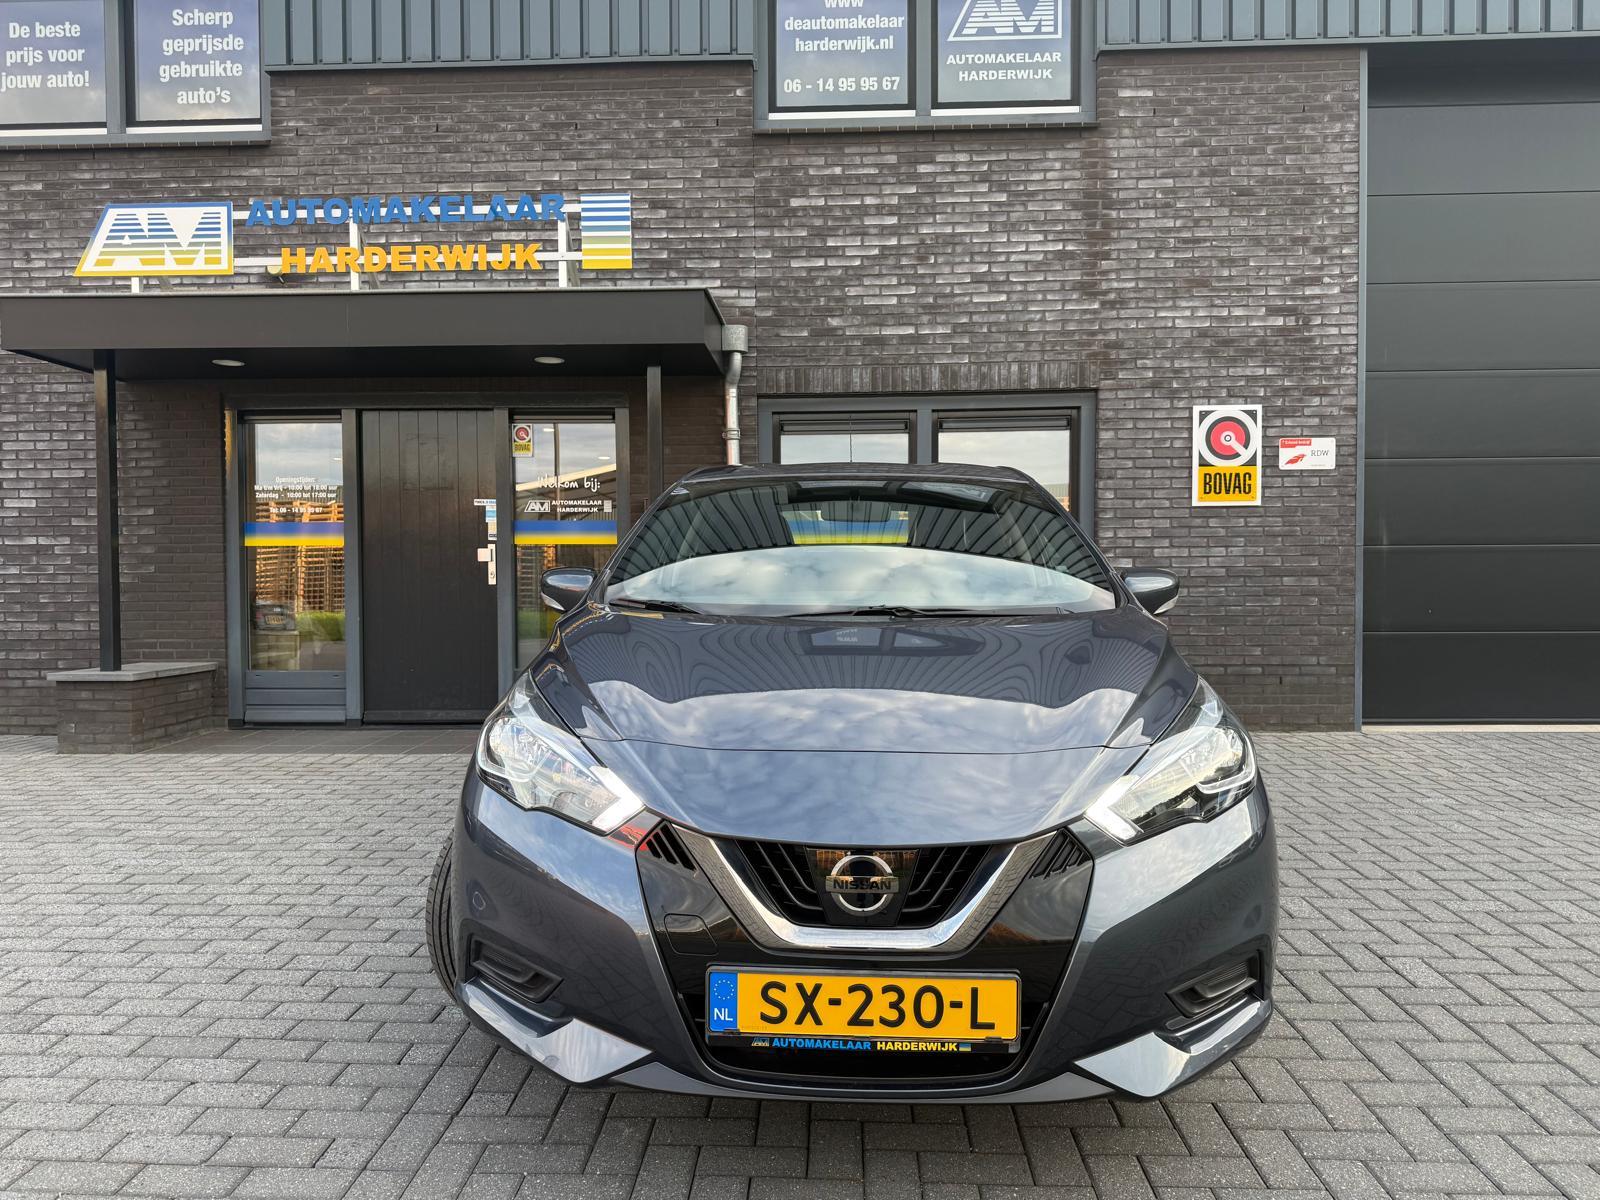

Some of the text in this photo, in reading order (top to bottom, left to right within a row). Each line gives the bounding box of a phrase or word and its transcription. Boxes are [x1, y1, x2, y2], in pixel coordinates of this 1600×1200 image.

[172, 8, 233, 28] Scherp
[784, 14, 905, 31] deautomakelaar
[9, 21, 81, 39] De beste
[162, 34, 244, 55] geprijsde
[795, 34, 894, 53] harderwijk.nl
[6, 47, 86, 67] prijs voor
[946, 51, 1062, 65] AUTOMAKELAAR
[159, 61, 243, 82] gebruikte
[958, 68, 1053, 82] HARDERWIJK
[0, 70, 90, 92] jouw auto!
[783, 78, 802, 93] 06
[816, 78, 835, 93] 14
[838, 77, 857, 92] 95
[859, 76, 878, 92] 95
[882, 76, 900, 91] 67
[176, 87, 232, 104] auto's
[245, 193, 567, 228] AUTOMAKELAAR
[94, 211, 223, 268] AM
[281, 243, 544, 273] HARDERWIJK
[1311, 449, 1329, 457] RDW
[584, 476, 601, 492] bij:
[1203, 472, 1252, 495] BOVAG
[833, 880, 892, 890] NISSAN
[759, 980, 996, 1031] SX-230-L
[713, 1008, 733, 1022] NL
[772, 1038, 872, 1050] AUTOMAKELAAR
[876, 1041, 958, 1052] HARDERWIJK
